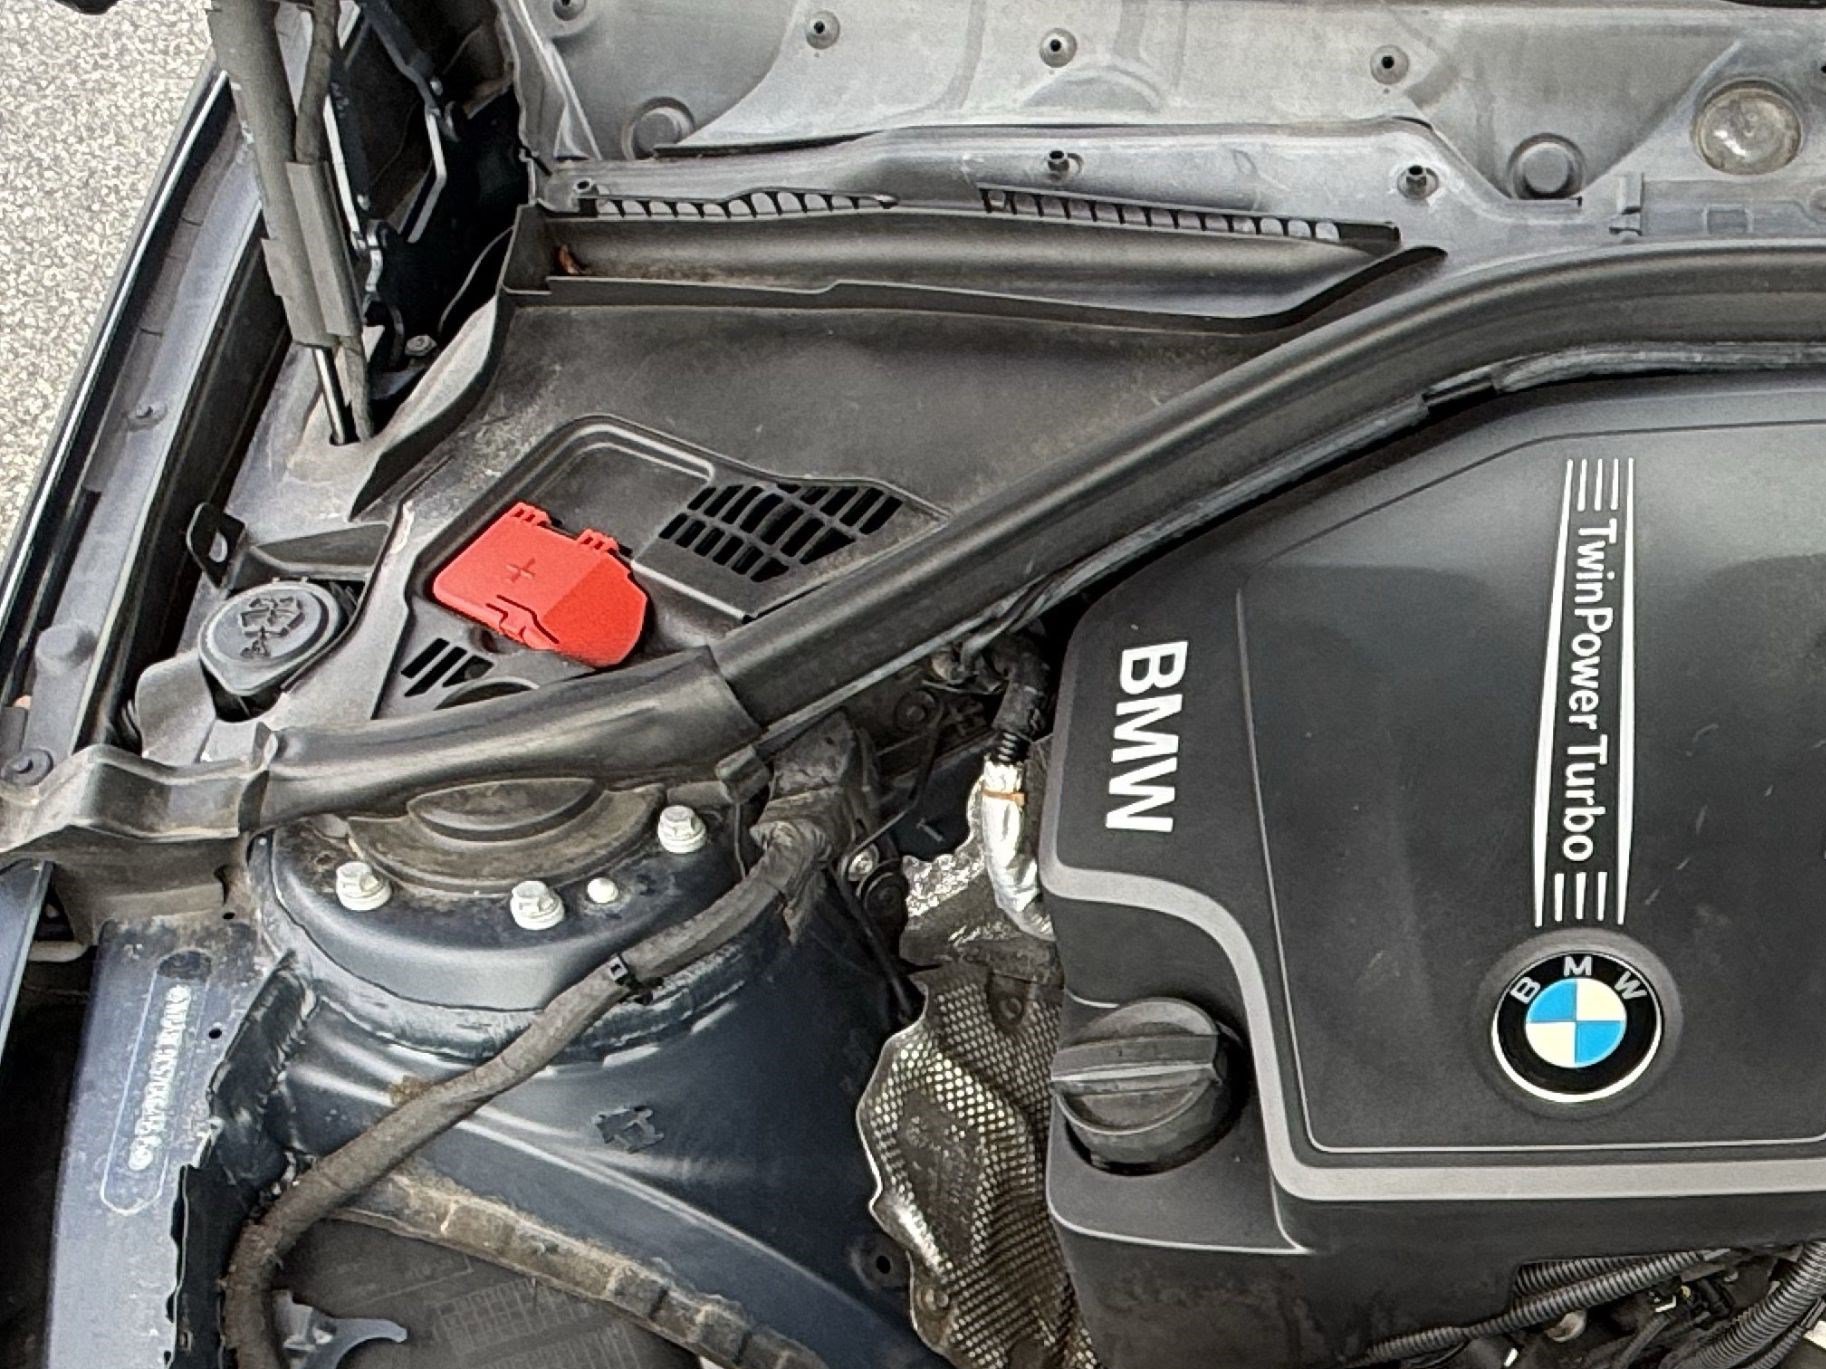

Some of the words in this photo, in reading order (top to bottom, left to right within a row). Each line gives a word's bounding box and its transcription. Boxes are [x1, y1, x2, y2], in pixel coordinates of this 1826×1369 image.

[1568, 518, 1618, 730] TwinPower
[1105, 640, 1188, 832] BMW
[1562, 734, 1608, 862] Turbo
[1509, 956, 1648, 1004] BMW
